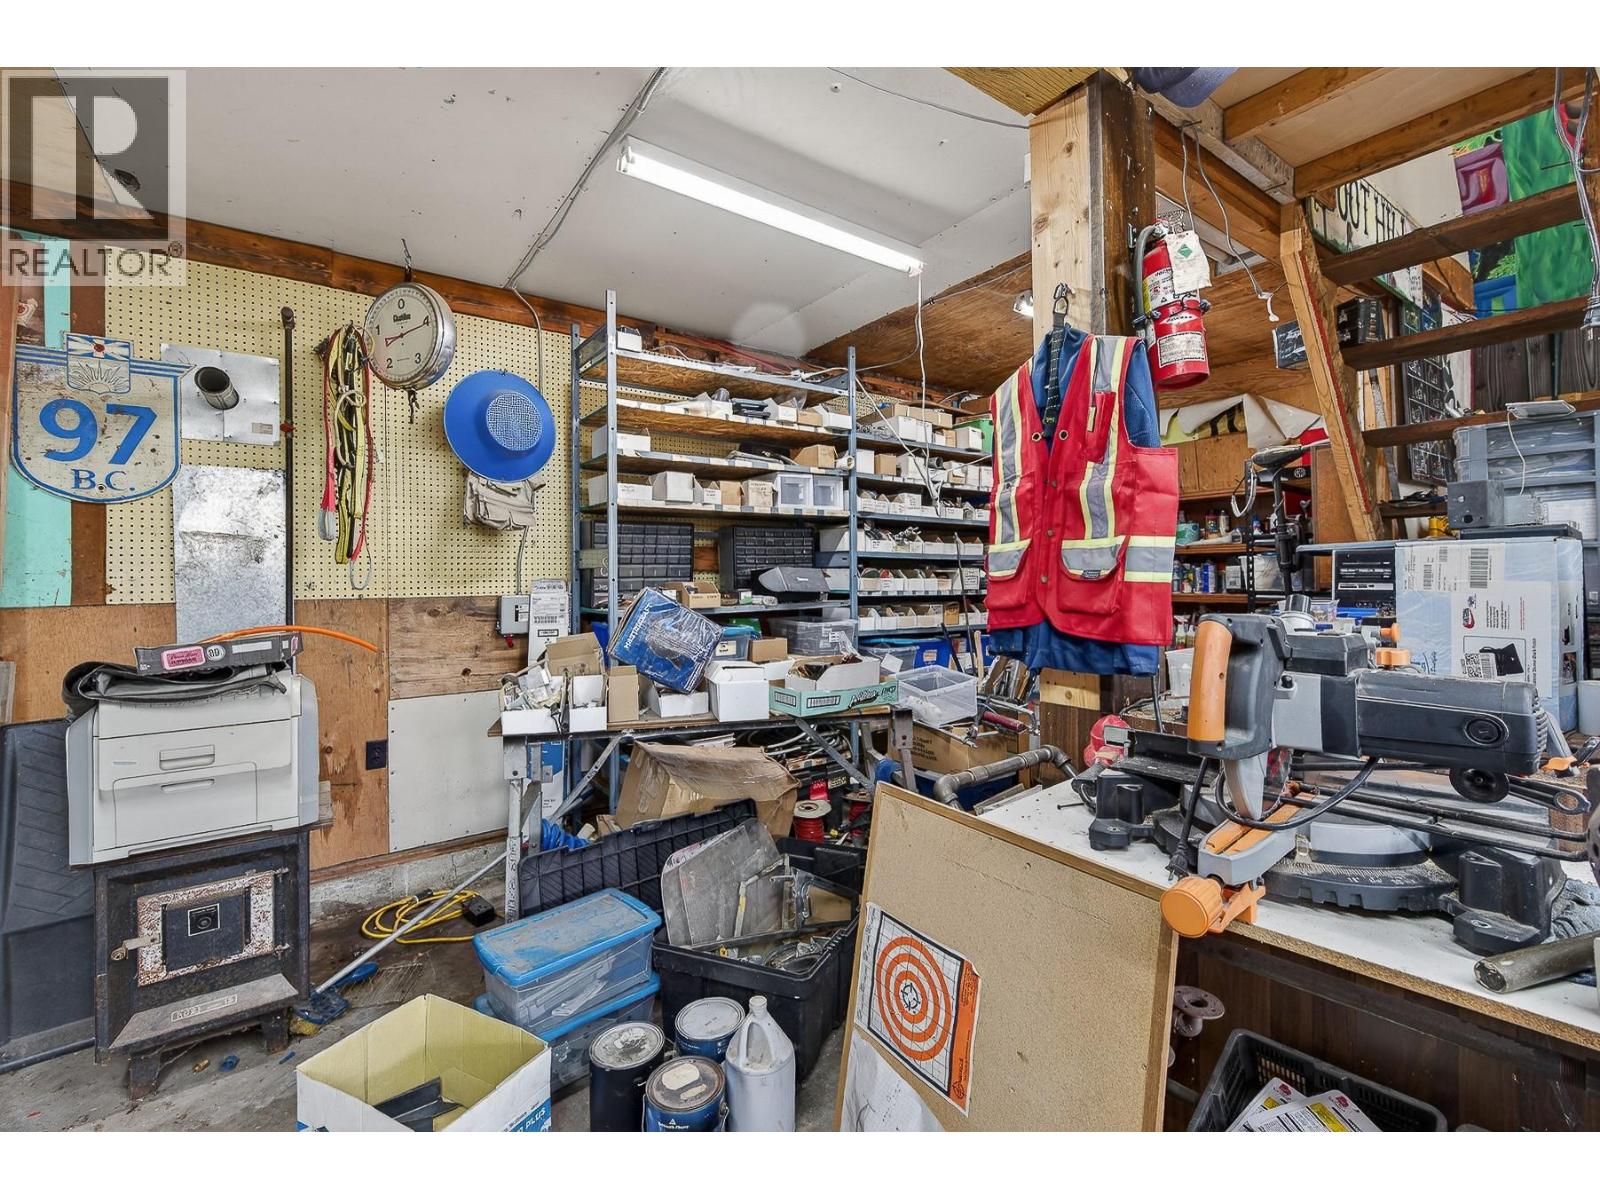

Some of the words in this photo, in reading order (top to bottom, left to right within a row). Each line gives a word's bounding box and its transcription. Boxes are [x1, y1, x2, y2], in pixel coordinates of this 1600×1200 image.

[398, 298, 405, 309] 0
[422, 315, 430, 326] 4
[375, 324, 380, 335] 1
[386, 357, 394, 369] 2
[414, 352, 422, 364] 3
[39, 398, 158, 465] 97
[70, 468, 136, 491] B.C.
